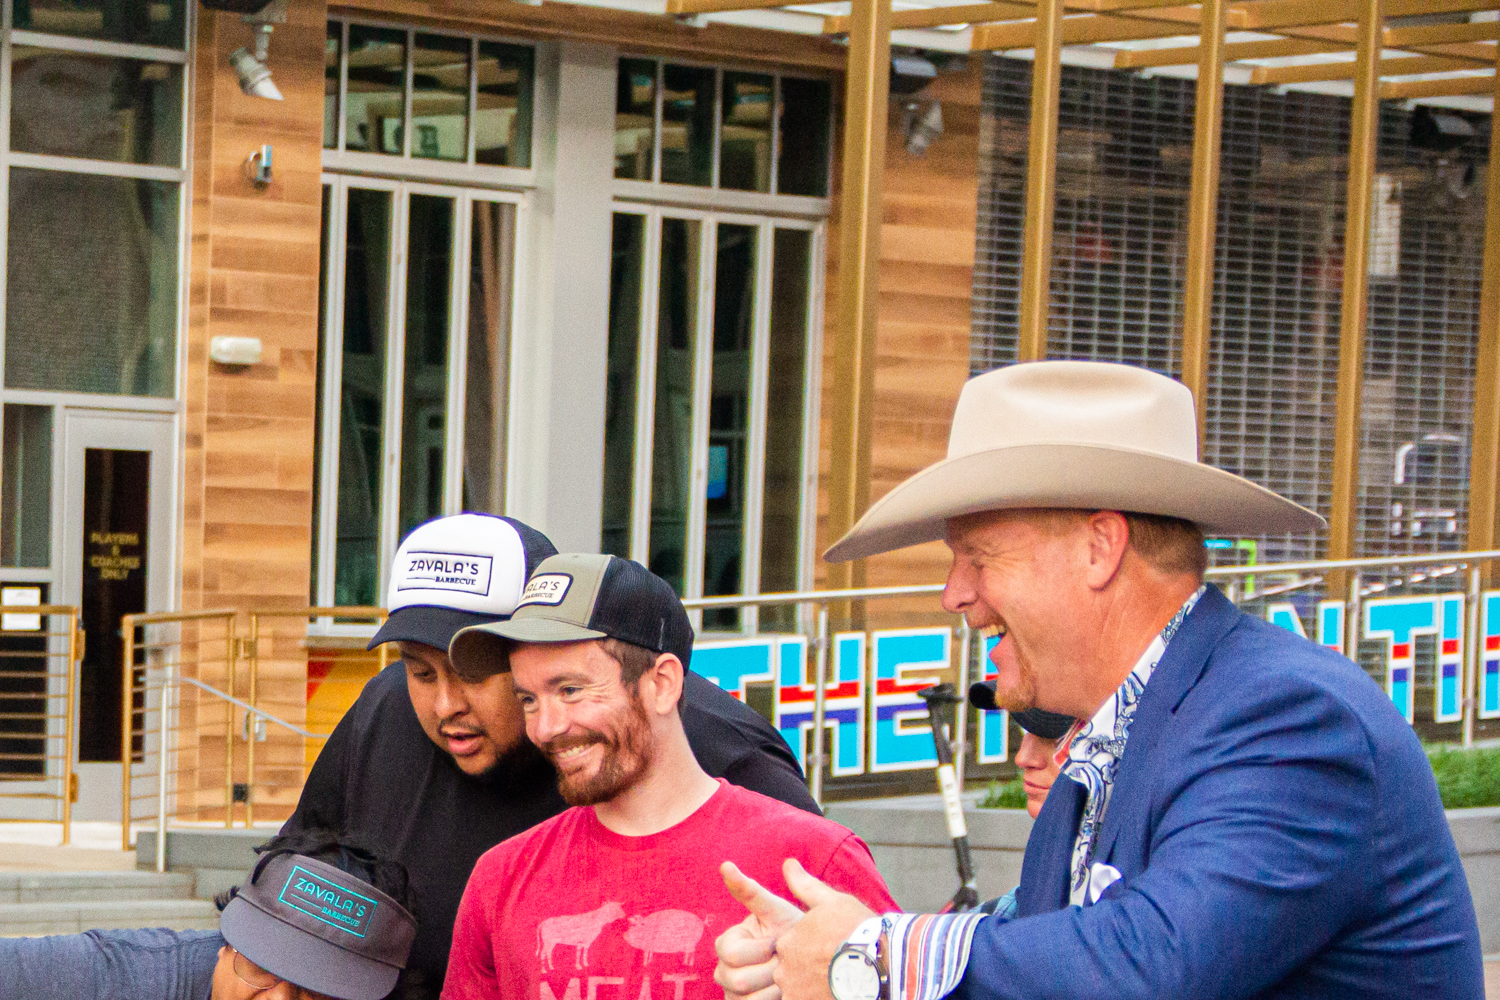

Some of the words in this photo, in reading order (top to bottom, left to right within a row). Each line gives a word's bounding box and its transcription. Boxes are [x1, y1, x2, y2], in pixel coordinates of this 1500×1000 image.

[408, 559, 480, 575] ZAVALA'S
[435, 575, 476, 586] BARBECUE
[527, 580, 561, 592] ALA'S
[294, 877, 367, 918] ZAVALA'S
[321, 906, 361, 928] BARBECUE
